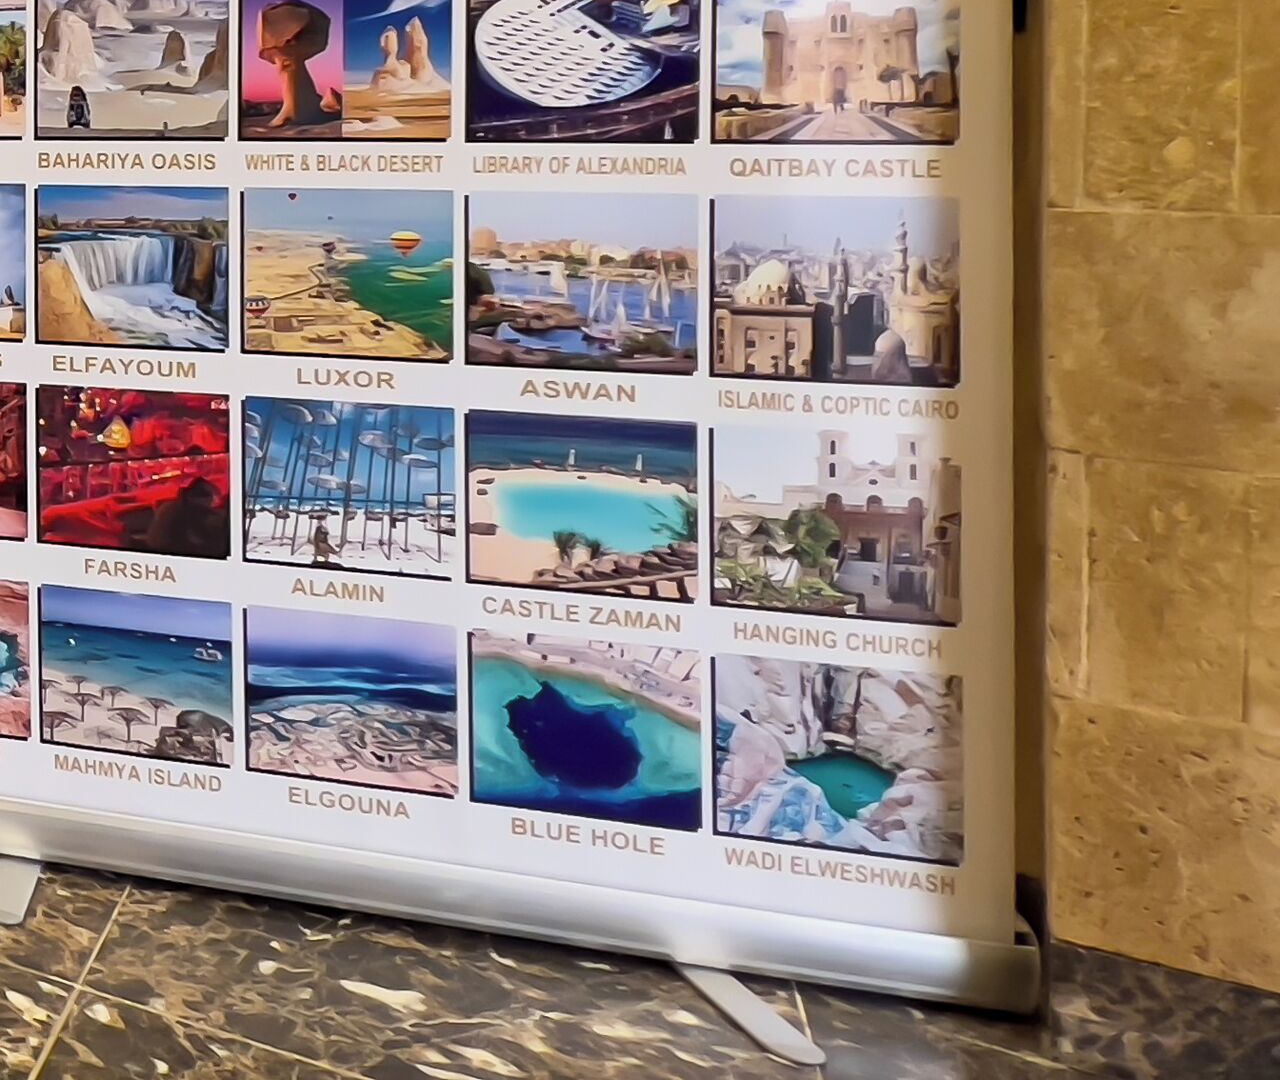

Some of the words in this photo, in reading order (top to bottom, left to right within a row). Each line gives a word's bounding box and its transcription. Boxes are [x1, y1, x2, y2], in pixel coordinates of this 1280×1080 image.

[38, 152, 145, 170] BAHARIYA
[151, 153, 216, 171] OASIS
[244, 153, 295, 172] WHITE
[300, 154, 311, 172] &
[316, 154, 372, 172] BLACK
[377, 154, 444, 173] DESERT
[472, 155, 544, 174] LIBRARY
[548, 156, 571, 175] OF
[575, 156, 687, 176] ALEXANDRIA
[729, 157, 836, 178] QAITBAY
[844, 157, 941, 179] CASTLE
[52, 355, 196, 379] ELFAYOUM
[296, 367, 395, 390] LUXOR
[519, 379, 636, 403] ASWAN
[718, 389, 795, 412] ISLAMIC
[801, 394, 814, 413] &
[820, 394, 891, 417] COPTIC
[898, 397, 960, 420] CAIRO
[84, 555, 177, 583] FARSHA
[291, 577, 384, 603] ALAMIN
[481, 596, 581, 623] CASTLE
[588, 602, 681, 633] ZAMAN
[733, 621, 837, 649] HANGING
[845, 631, 942, 659] CHURCH
[53, 754, 142, 783] MAHMYA
[147, 765, 223, 793] ISLAND
[287, 785, 410, 819] ELGOUNA
[510, 817, 580, 844] BLUE
[591, 828, 665, 856] HOLE
[724, 847, 782, 872] WADI
[790, 854, 956, 896] ELWESHWASH
